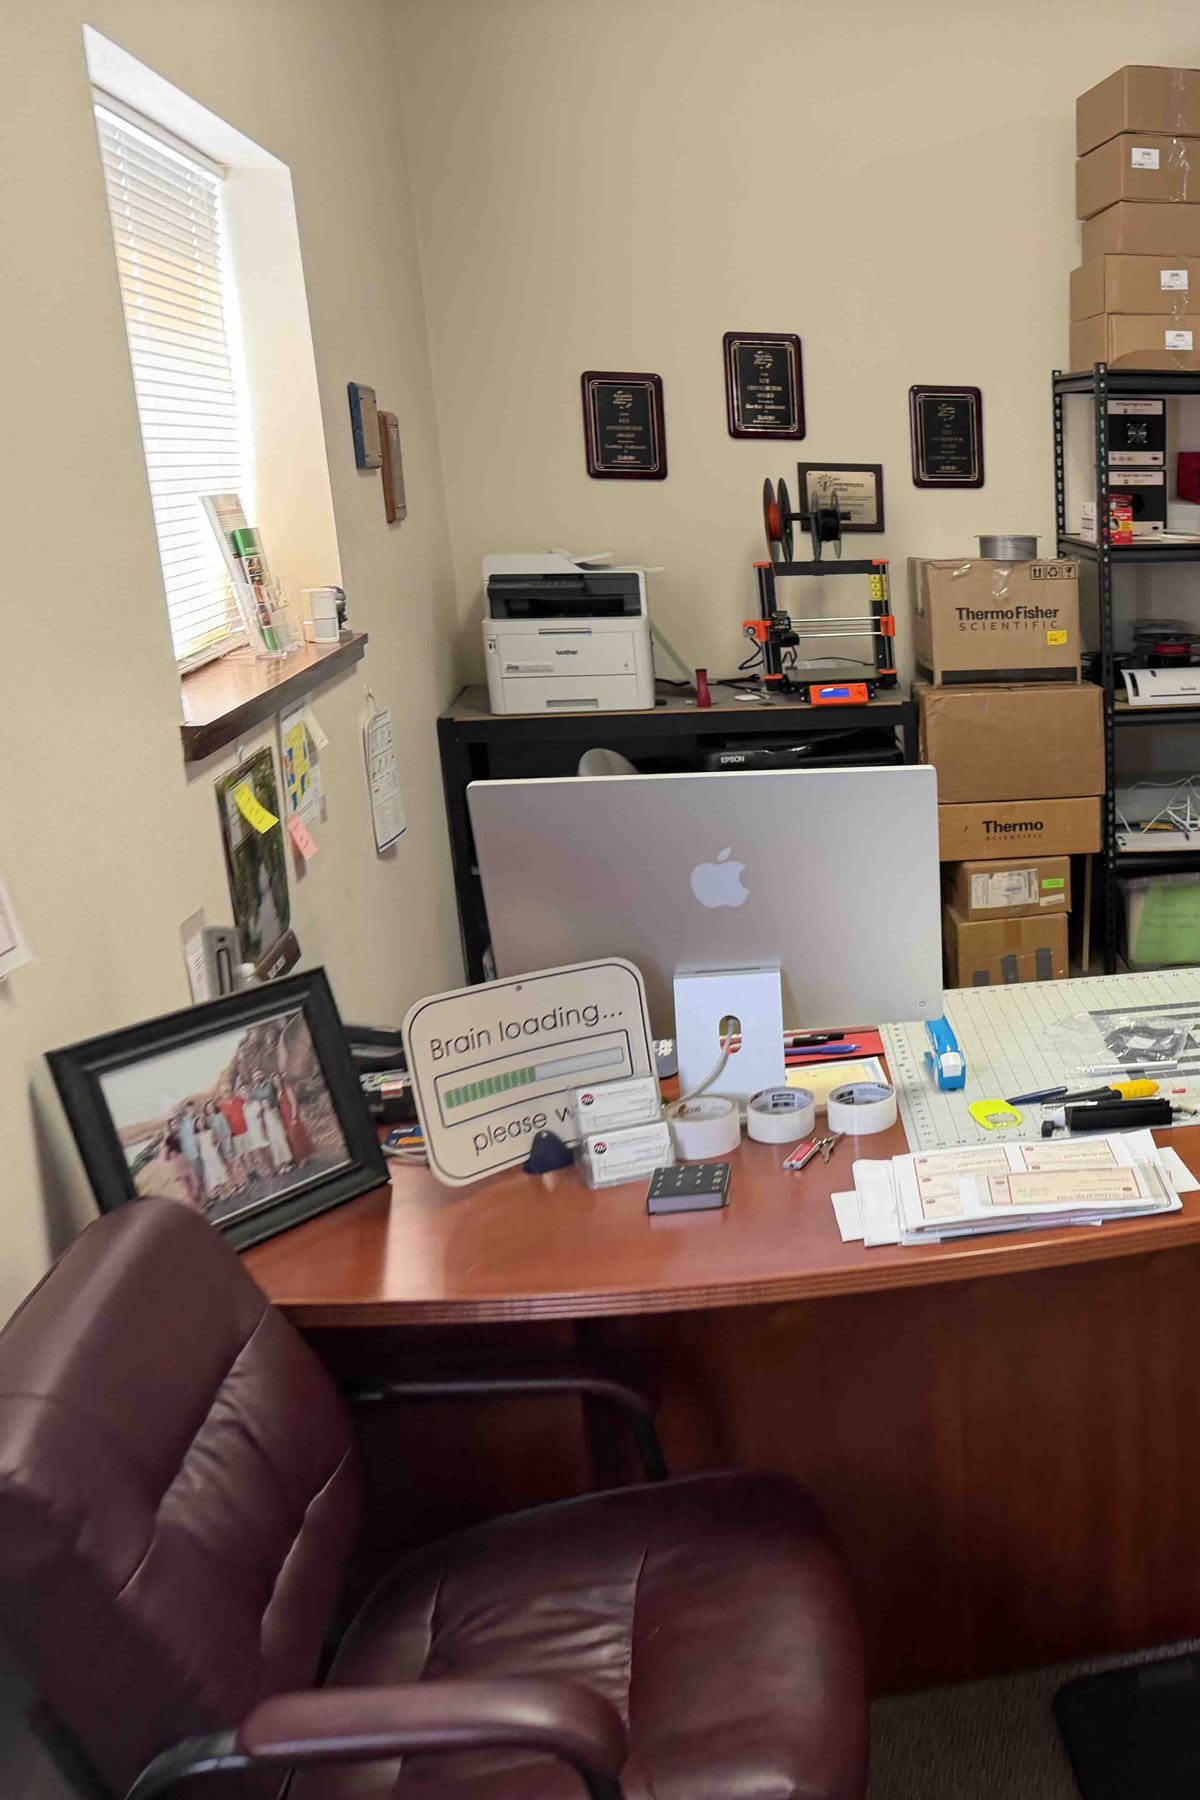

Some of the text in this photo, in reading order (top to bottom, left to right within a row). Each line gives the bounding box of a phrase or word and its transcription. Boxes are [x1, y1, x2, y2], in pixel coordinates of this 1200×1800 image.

[958, 620, 1059, 632] SCIENTIFIC
[720, 756, 745, 764] EPSON
[982, 820, 1045, 834] Thermo
[429, 1002, 624, 1061] Brain loading...
[472, 1111, 548, 1156] please
